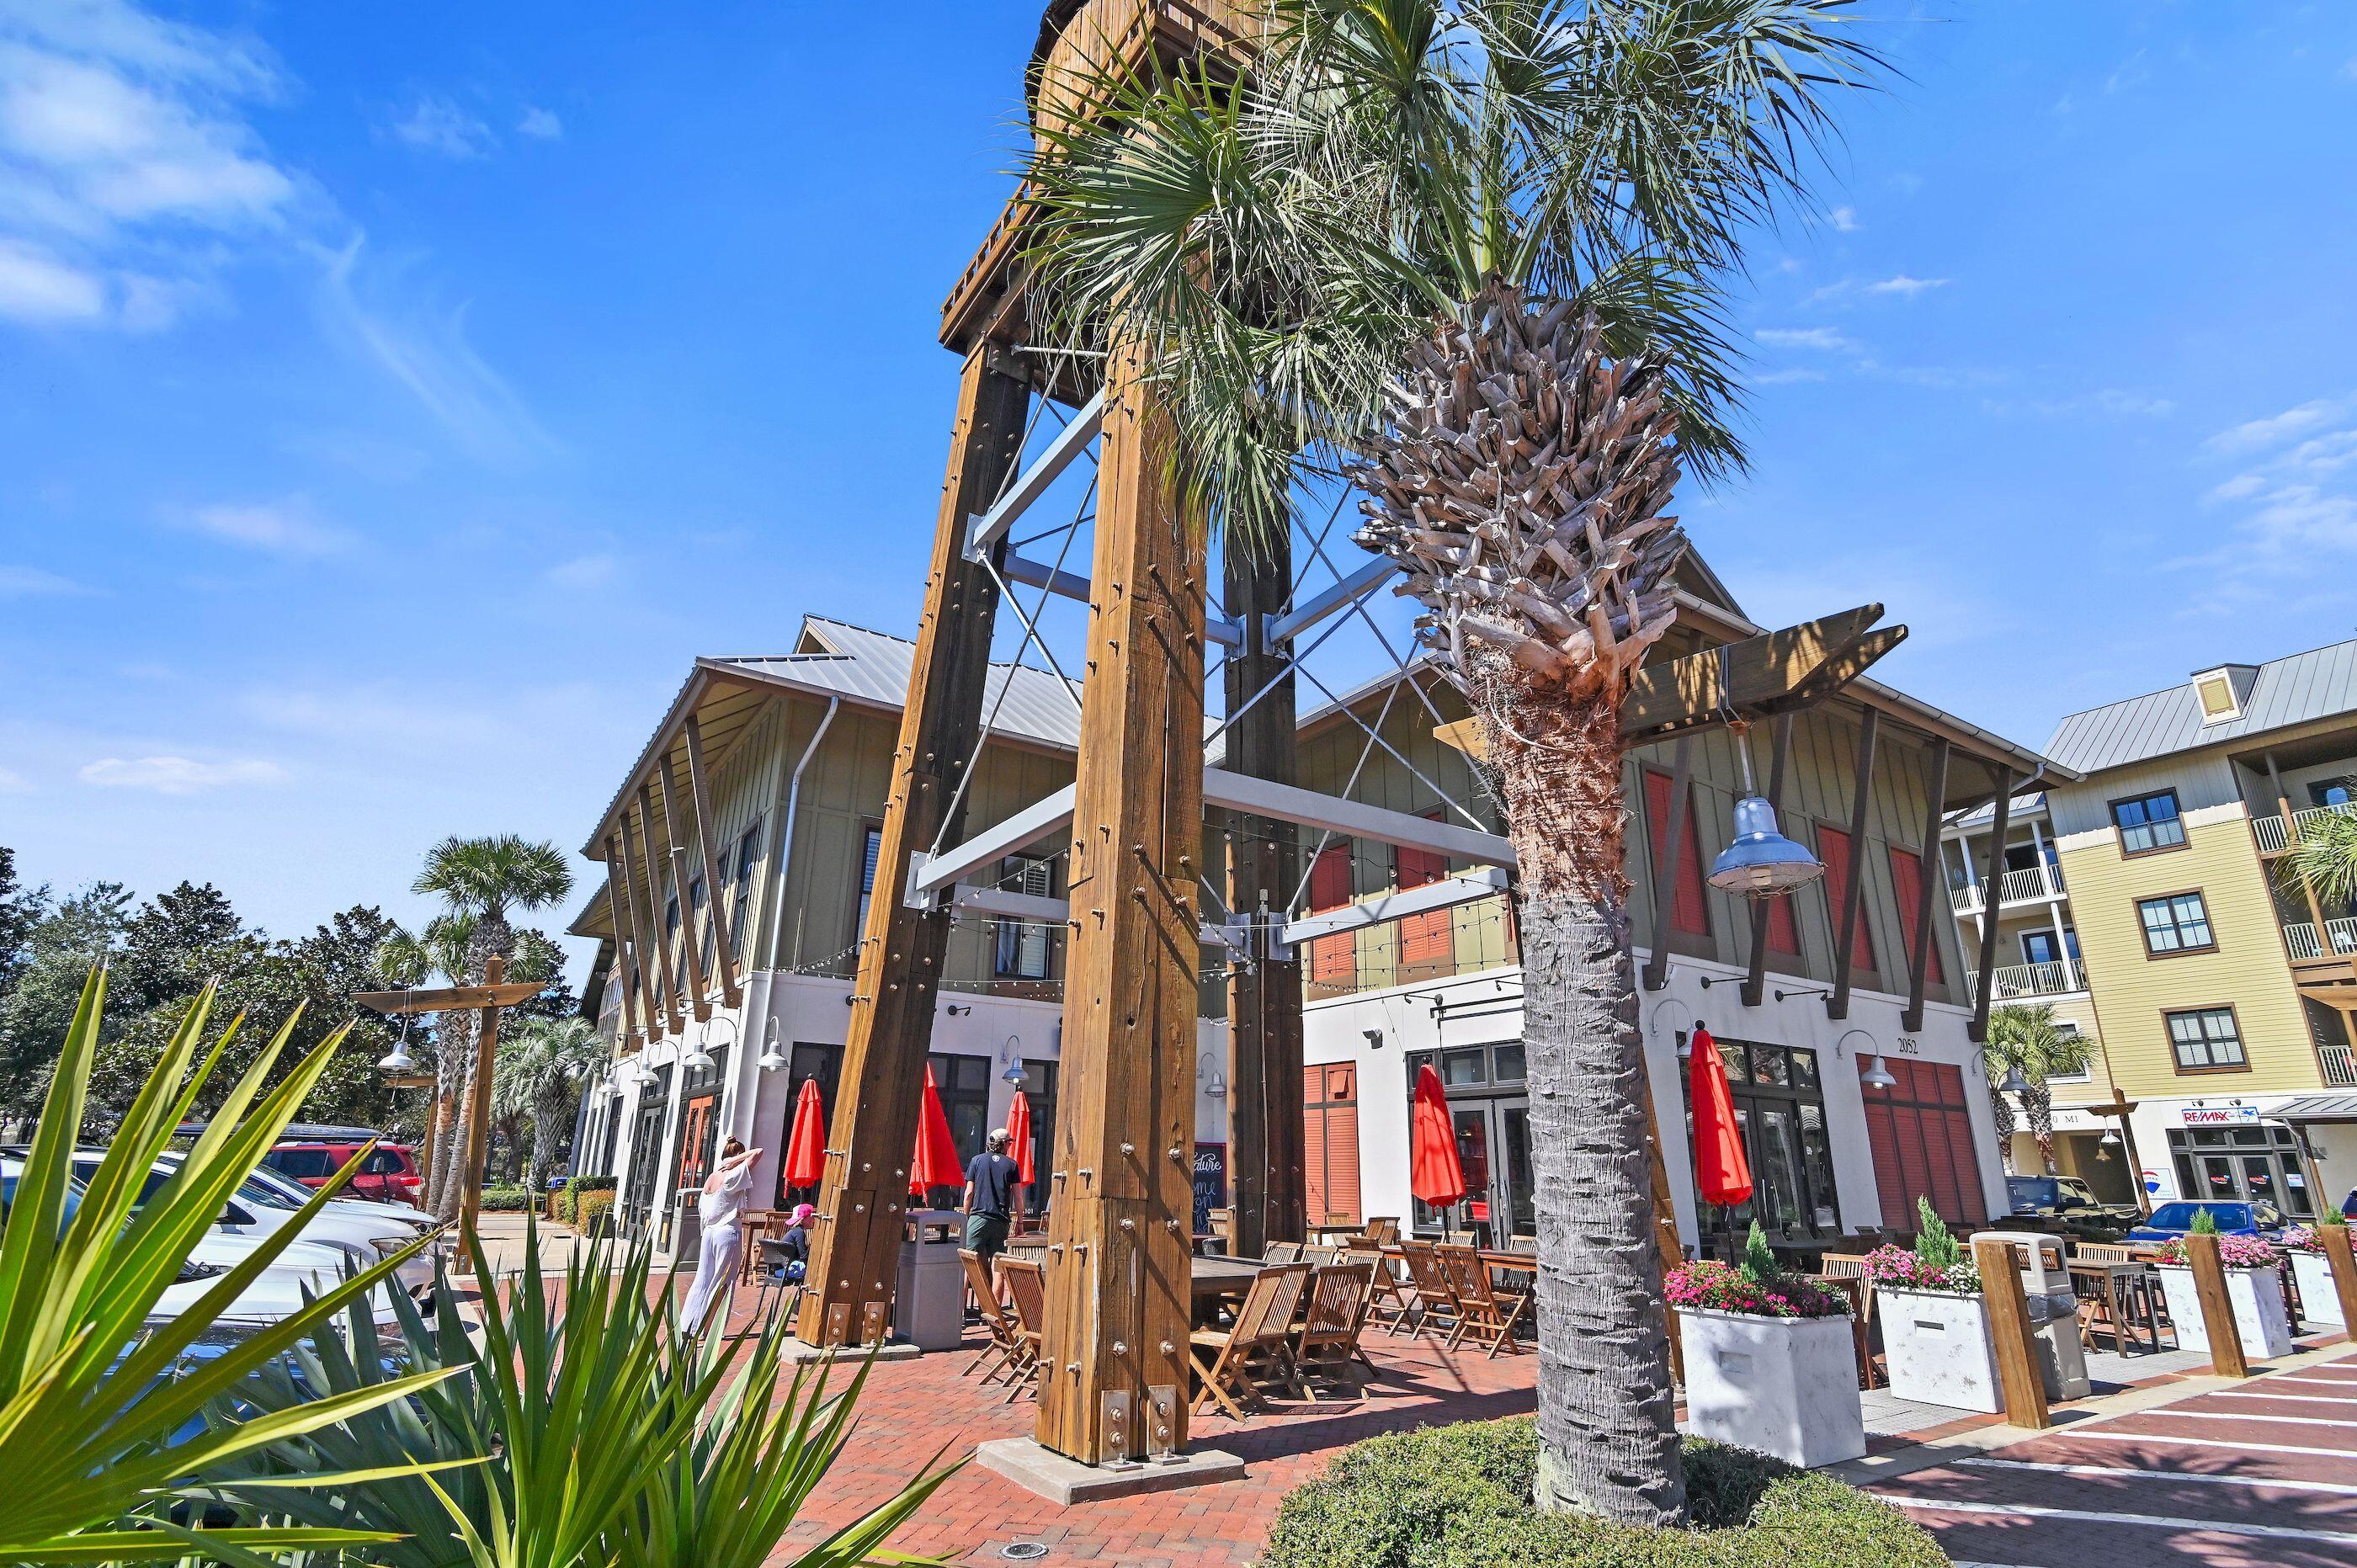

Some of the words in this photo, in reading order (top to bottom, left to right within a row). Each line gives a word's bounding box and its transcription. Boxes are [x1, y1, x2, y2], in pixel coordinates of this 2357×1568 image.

[1897, 1038, 1918, 1054] 2052
[2184, 1111, 2229, 1123] RE/MAX
[1193, 1181, 1216, 1196] me
